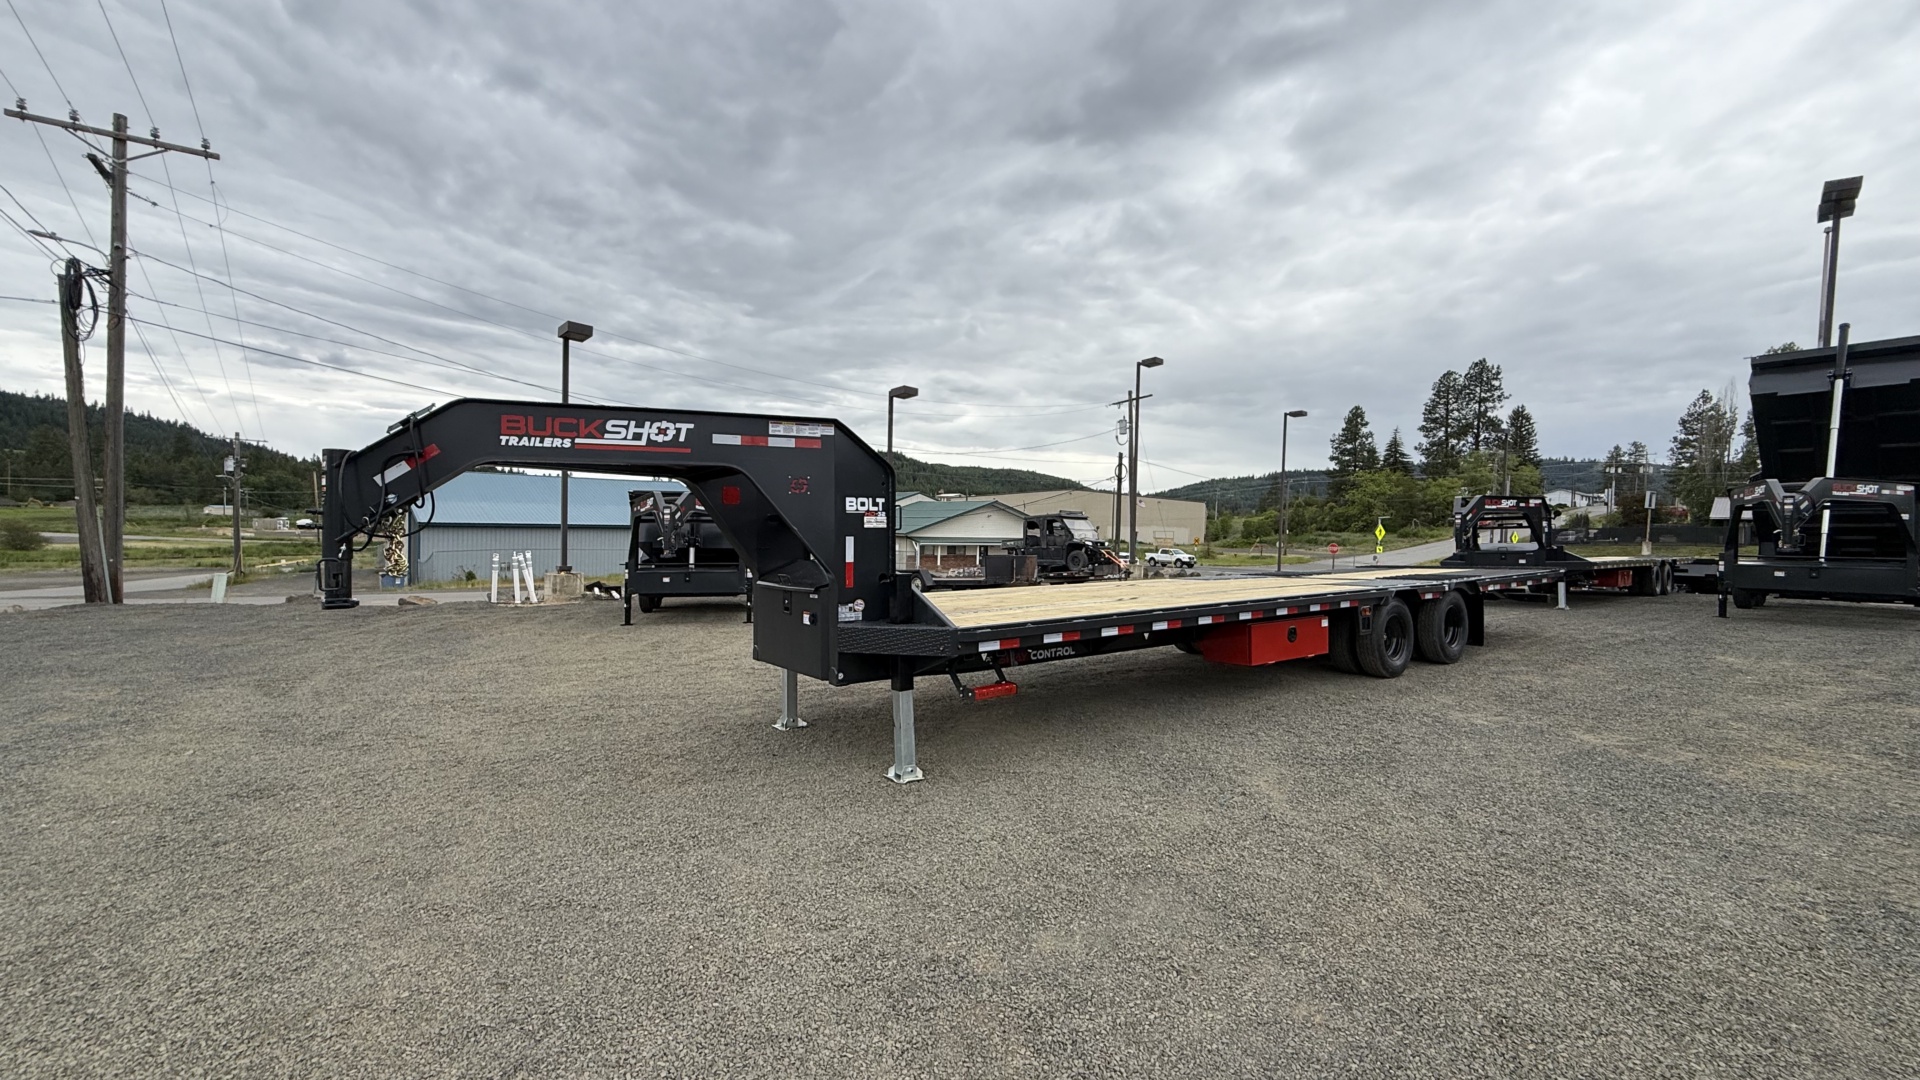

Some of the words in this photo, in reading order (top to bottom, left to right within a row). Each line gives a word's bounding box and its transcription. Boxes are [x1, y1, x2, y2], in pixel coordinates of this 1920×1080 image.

[500, 414, 695, 444] BUCKSHOT
[500, 435, 571, 448] TRAILERS
[845, 496, 886, 511] BOLT
[1030, 646, 1075, 660] CONTROL
